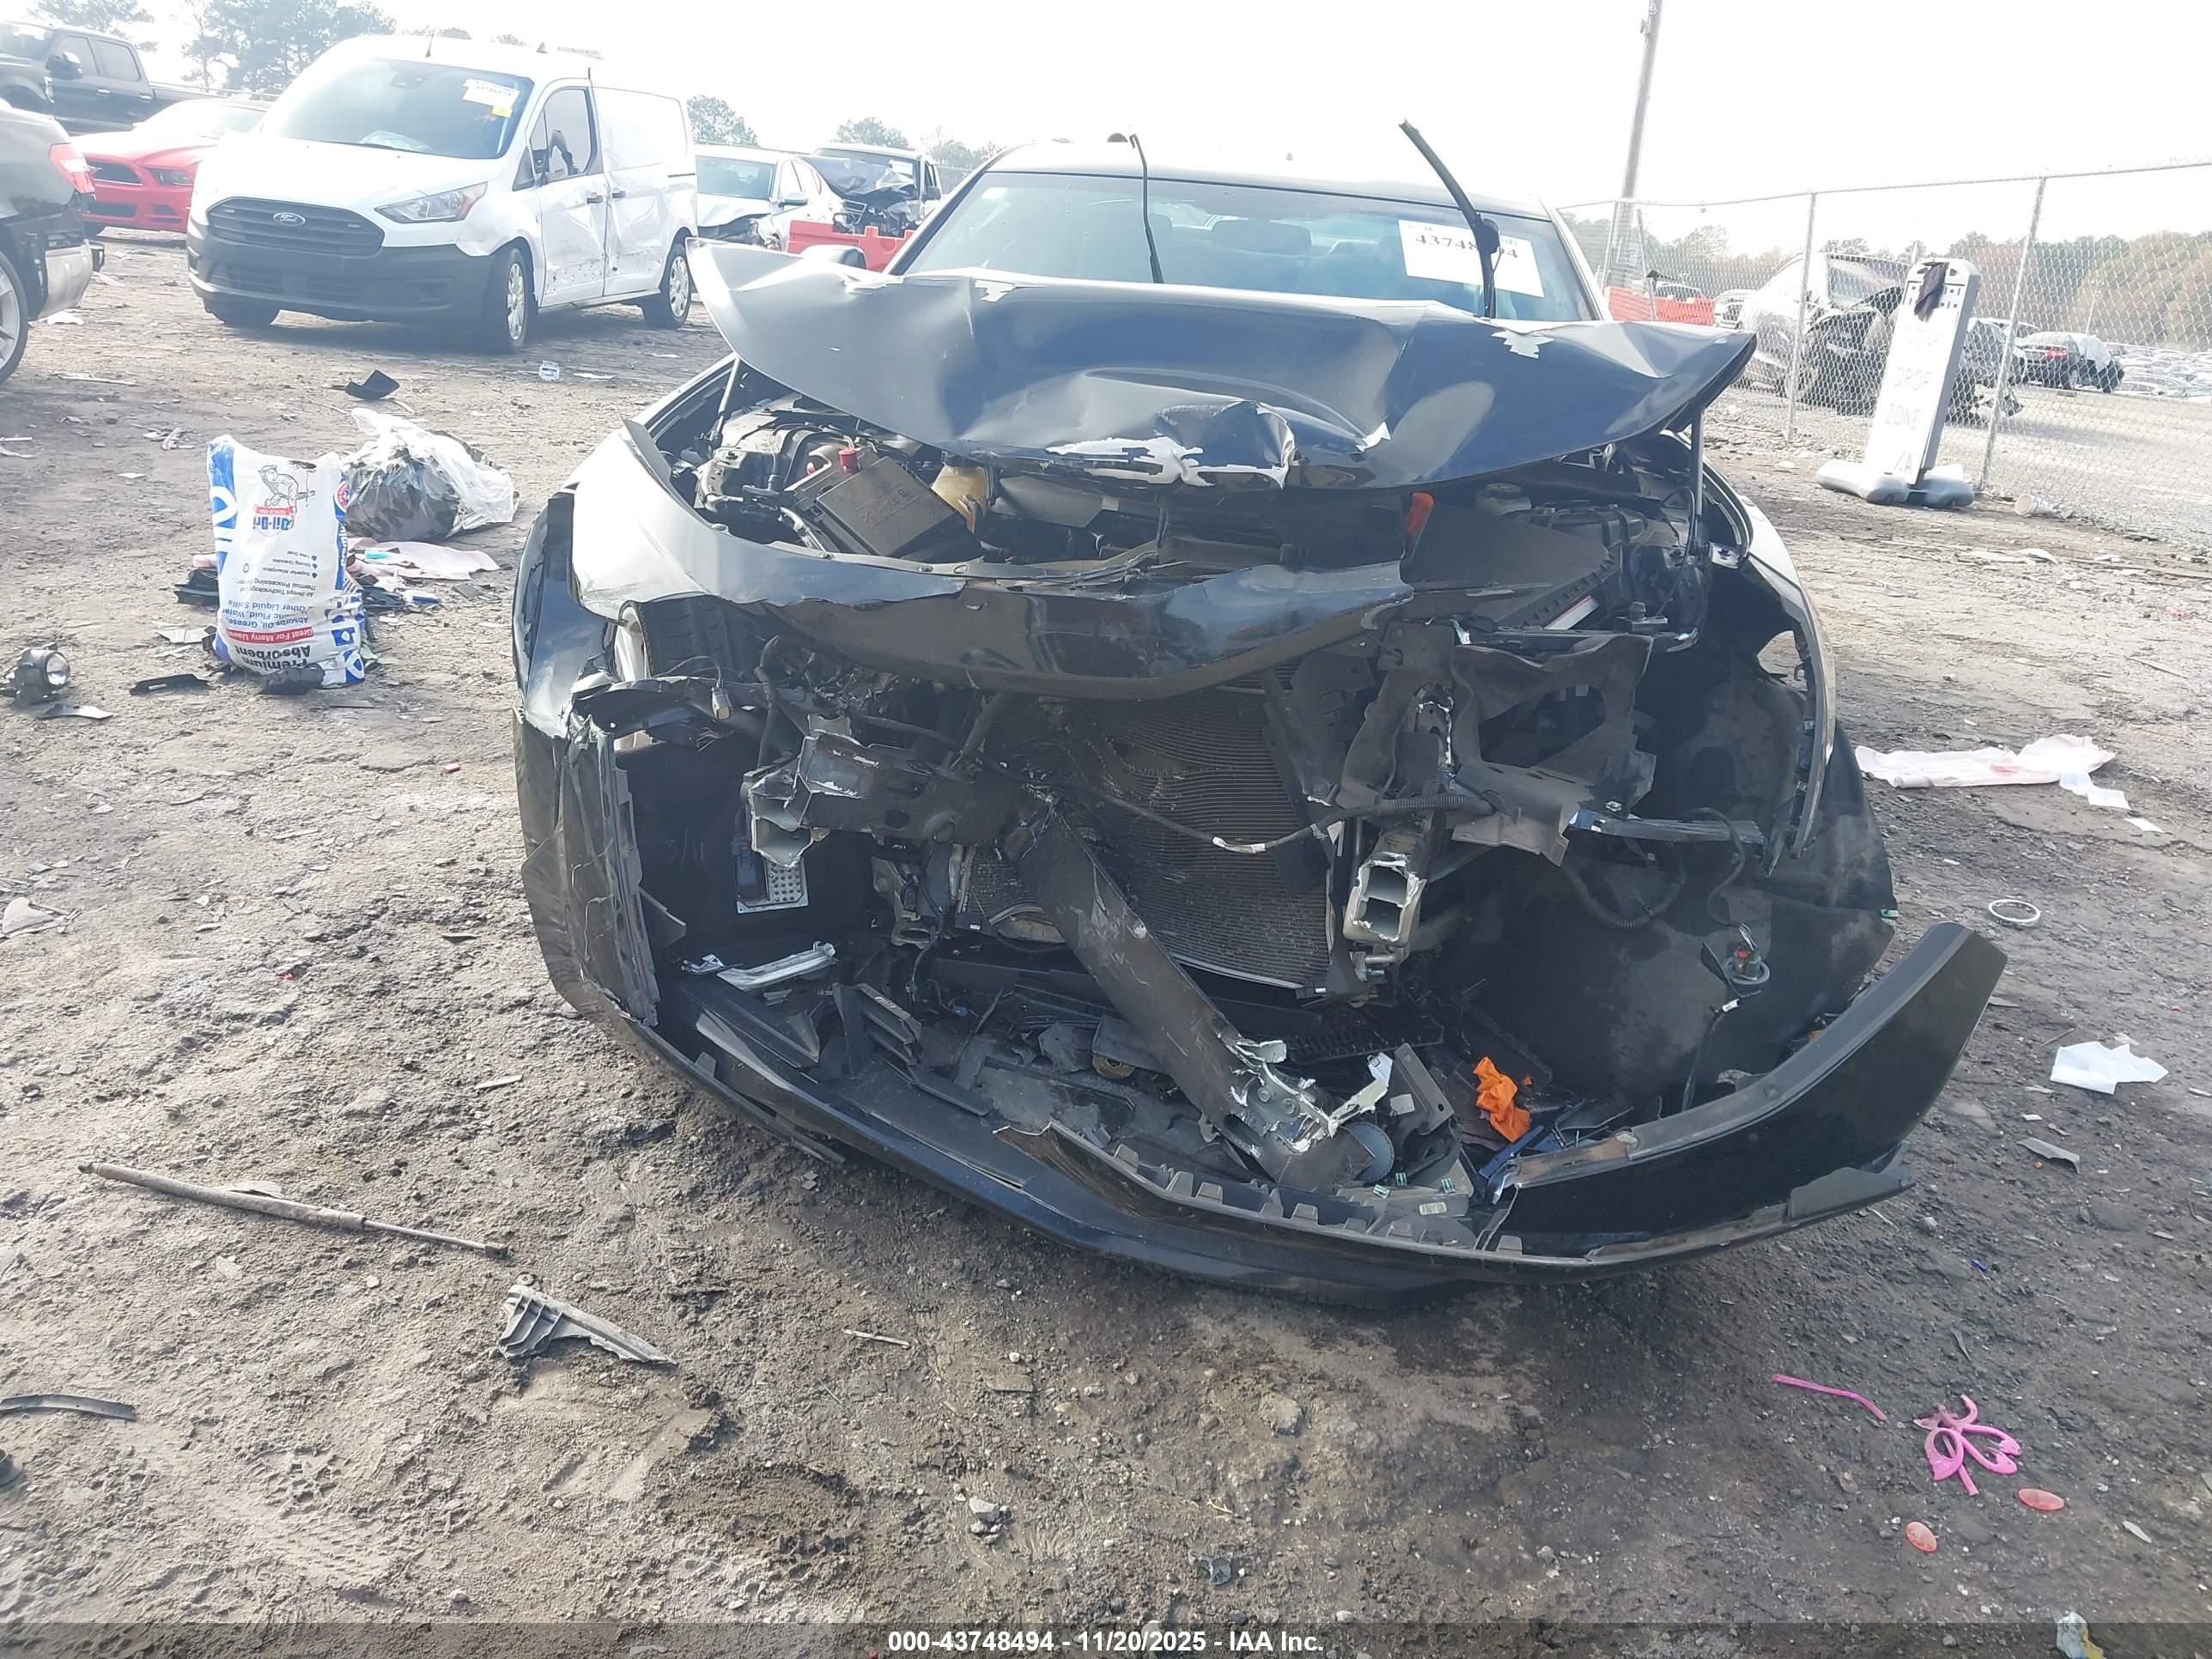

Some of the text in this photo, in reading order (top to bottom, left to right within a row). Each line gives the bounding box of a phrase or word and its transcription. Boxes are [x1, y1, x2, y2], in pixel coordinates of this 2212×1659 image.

[1893, 365, 1932, 391] DROP
[1884, 403, 1923, 430] ZONE
[254, 578, 290, 587] Processing
[249, 586, 285, 595] Technology
[252, 602, 279, 612] Liquid
[282, 605, 306, 613] Other
[222, 609, 245, 618] Water
[226, 617, 258, 629] Grease,
[276, 617, 308, 627] Absorbs
[251, 632, 273, 642] Many
[291, 629, 313, 637] Great
[234, 645, 311, 660] Absorbent
[242, 657, 307, 671] Premium
